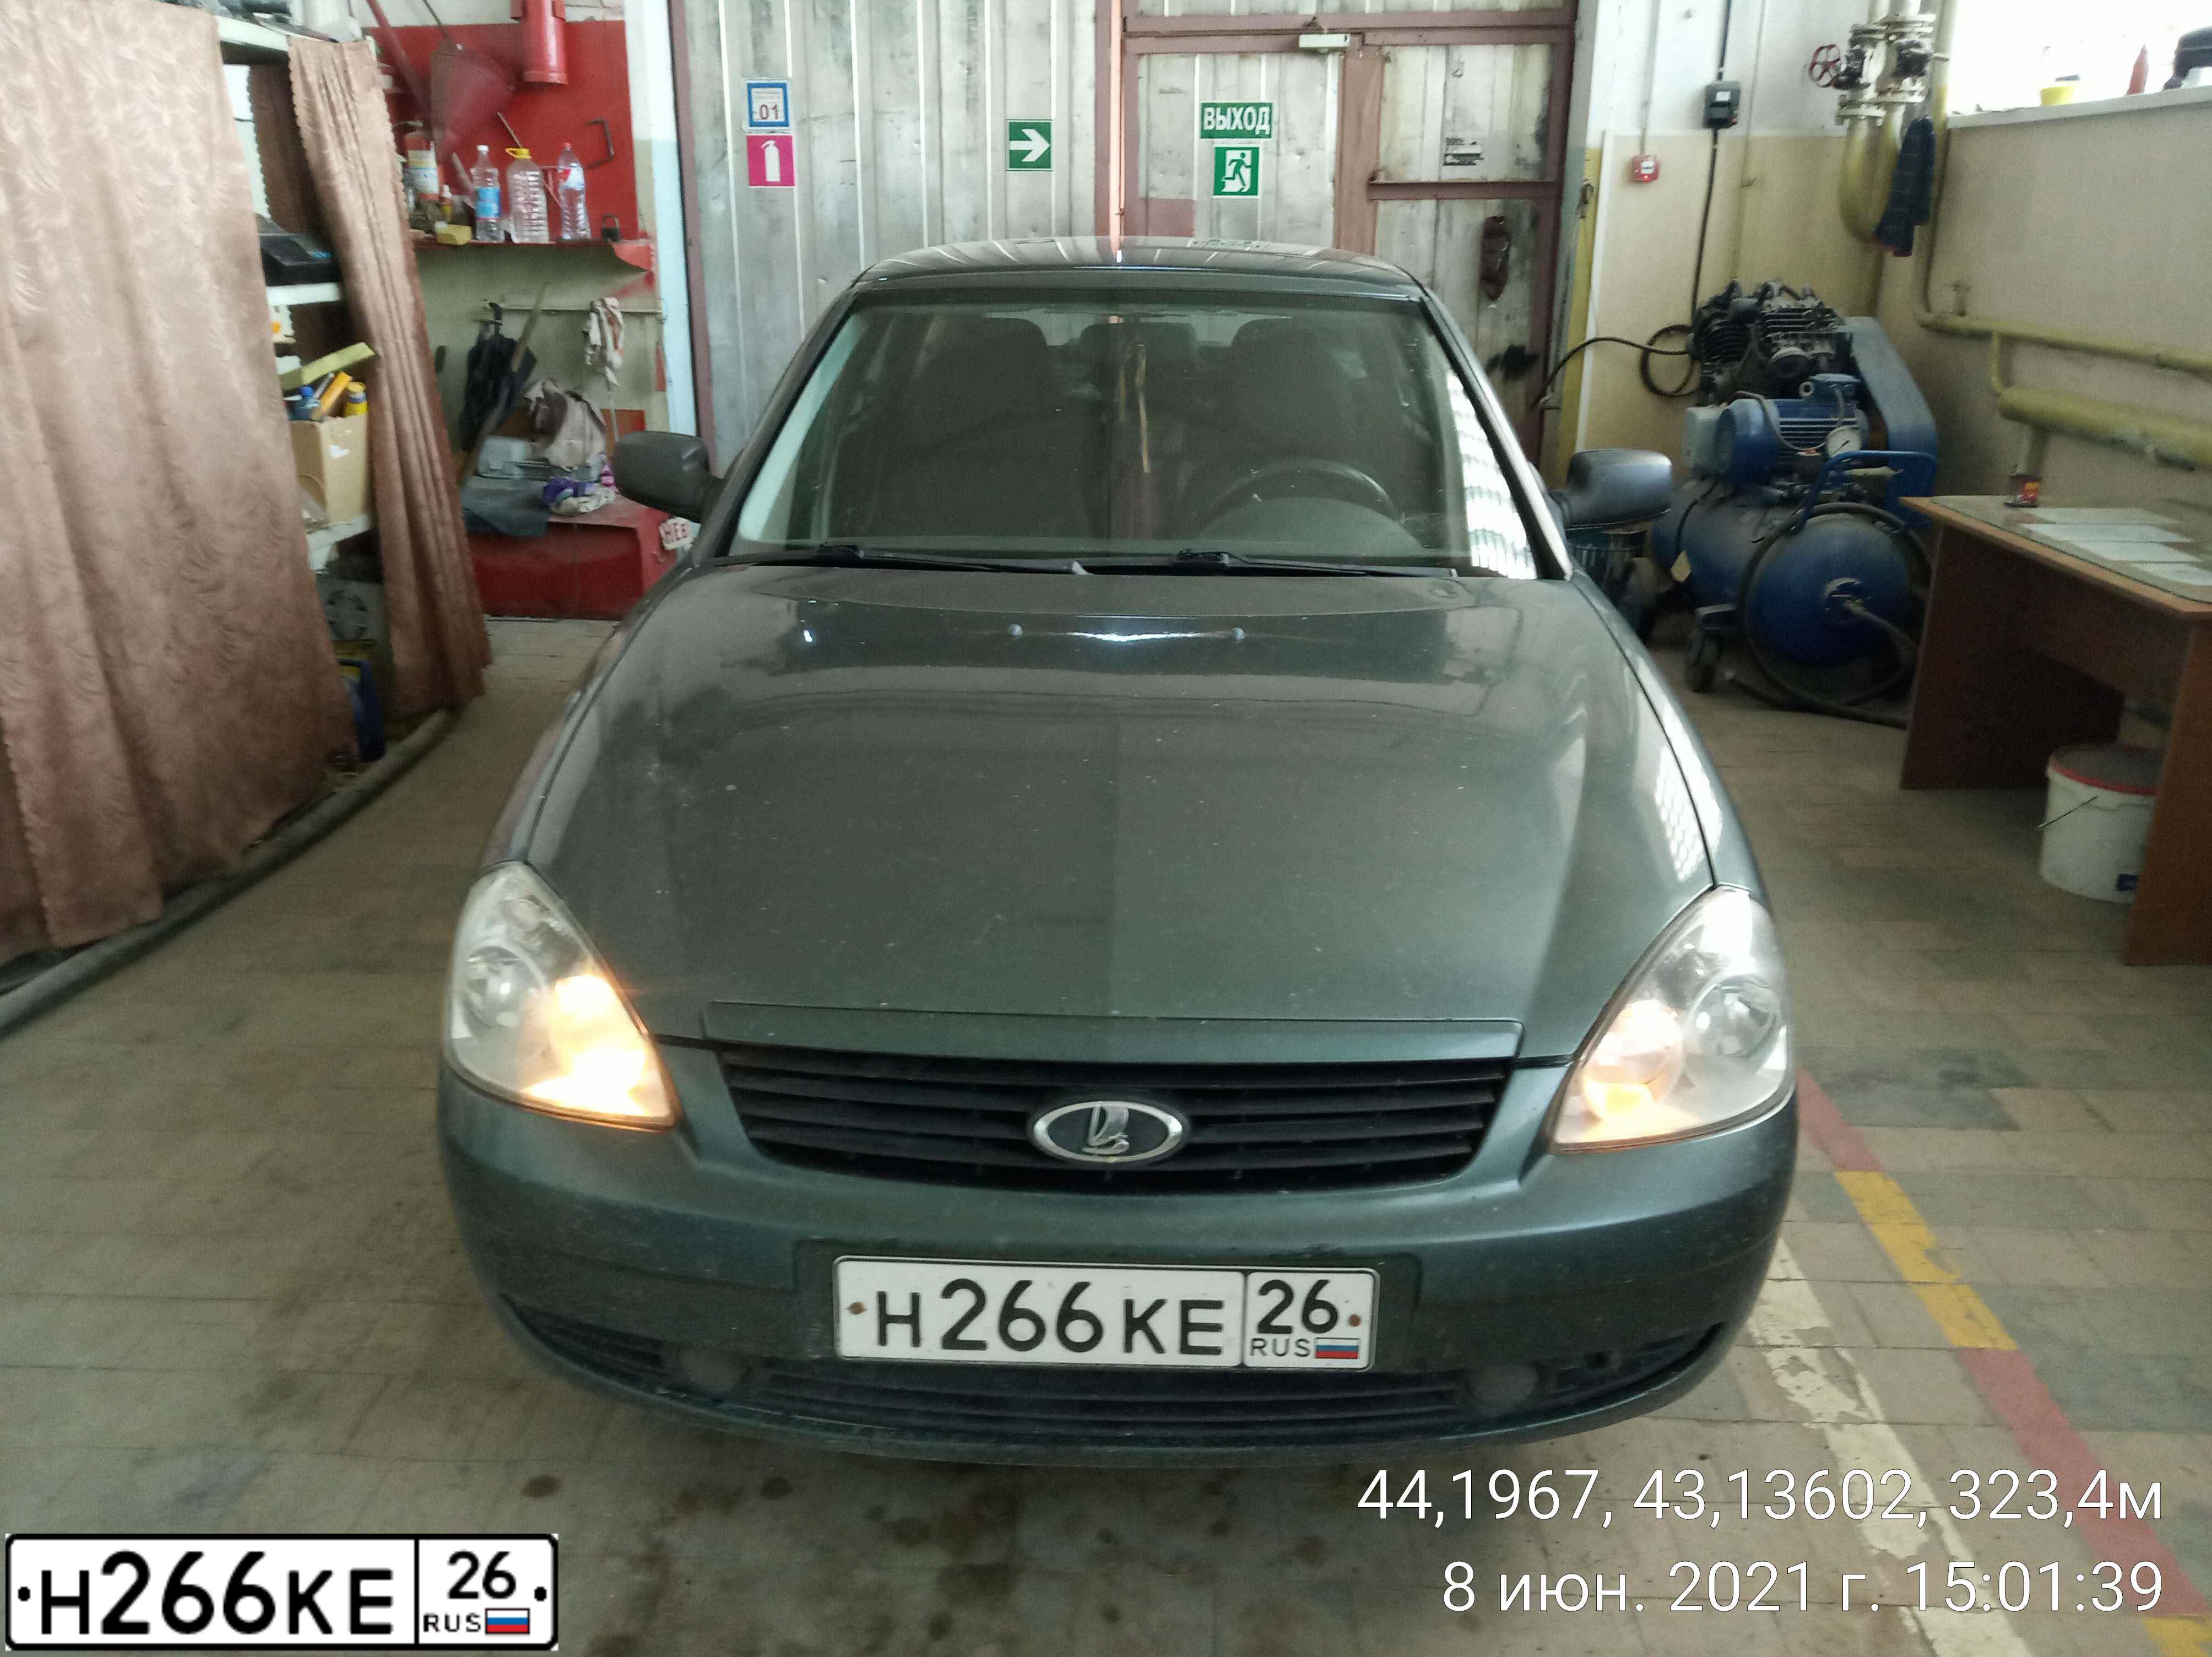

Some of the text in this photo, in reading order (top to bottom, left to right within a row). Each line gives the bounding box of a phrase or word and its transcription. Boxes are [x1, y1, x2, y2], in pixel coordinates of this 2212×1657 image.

[760, 104, 779, 120] 01
[1203, 106, 1271, 135] ВЫХОД
[1256, 1279, 1338, 1334] 26
[1250, 1337, 1310, 1357] RUS
